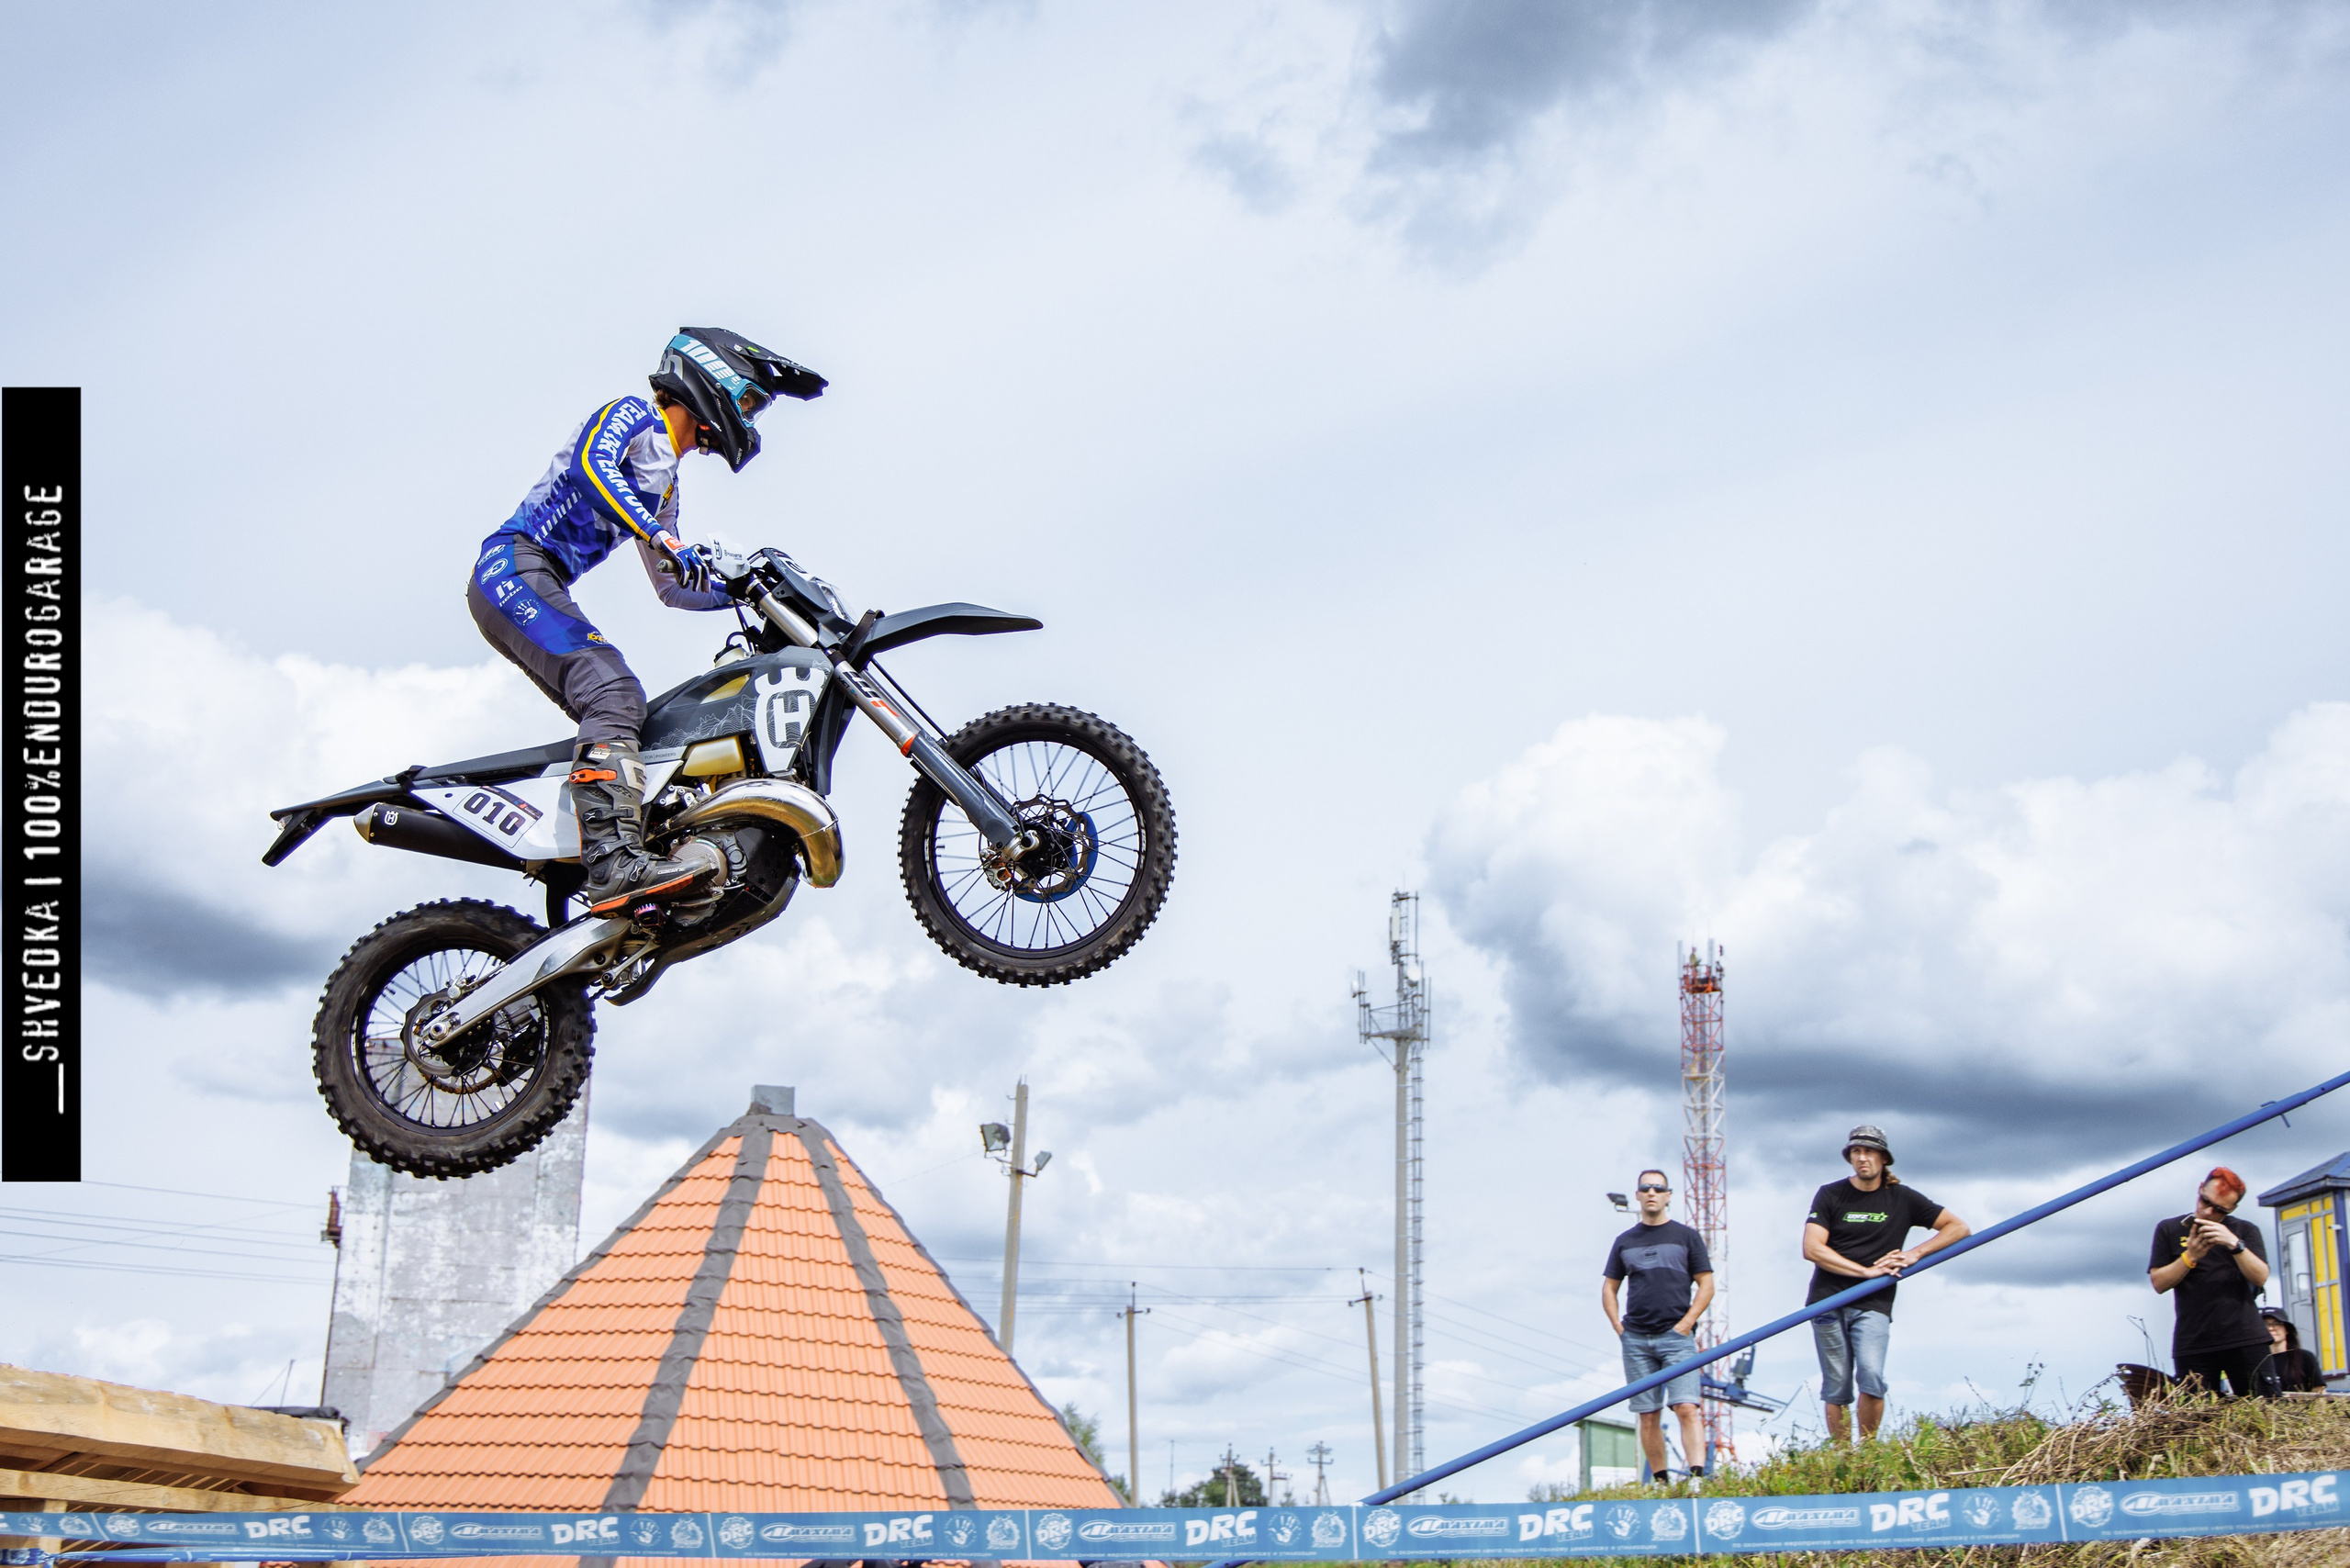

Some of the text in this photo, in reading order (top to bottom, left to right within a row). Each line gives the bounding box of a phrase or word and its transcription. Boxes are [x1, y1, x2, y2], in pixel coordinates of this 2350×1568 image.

[607, 398, 648, 439] TEAM
[464, 792, 526, 836] 010
[1869, 1492, 1951, 1532] DRC
[2248, 1474, 2338, 1518] DRC
[244, 1515, 311, 1539] DRC
[552, 1516, 619, 1544] DRC
[864, 1515, 934, 1547] DRC
[1185, 1510, 1258, 1547] DRC
[1518, 1504, 1594, 1541] DRC
